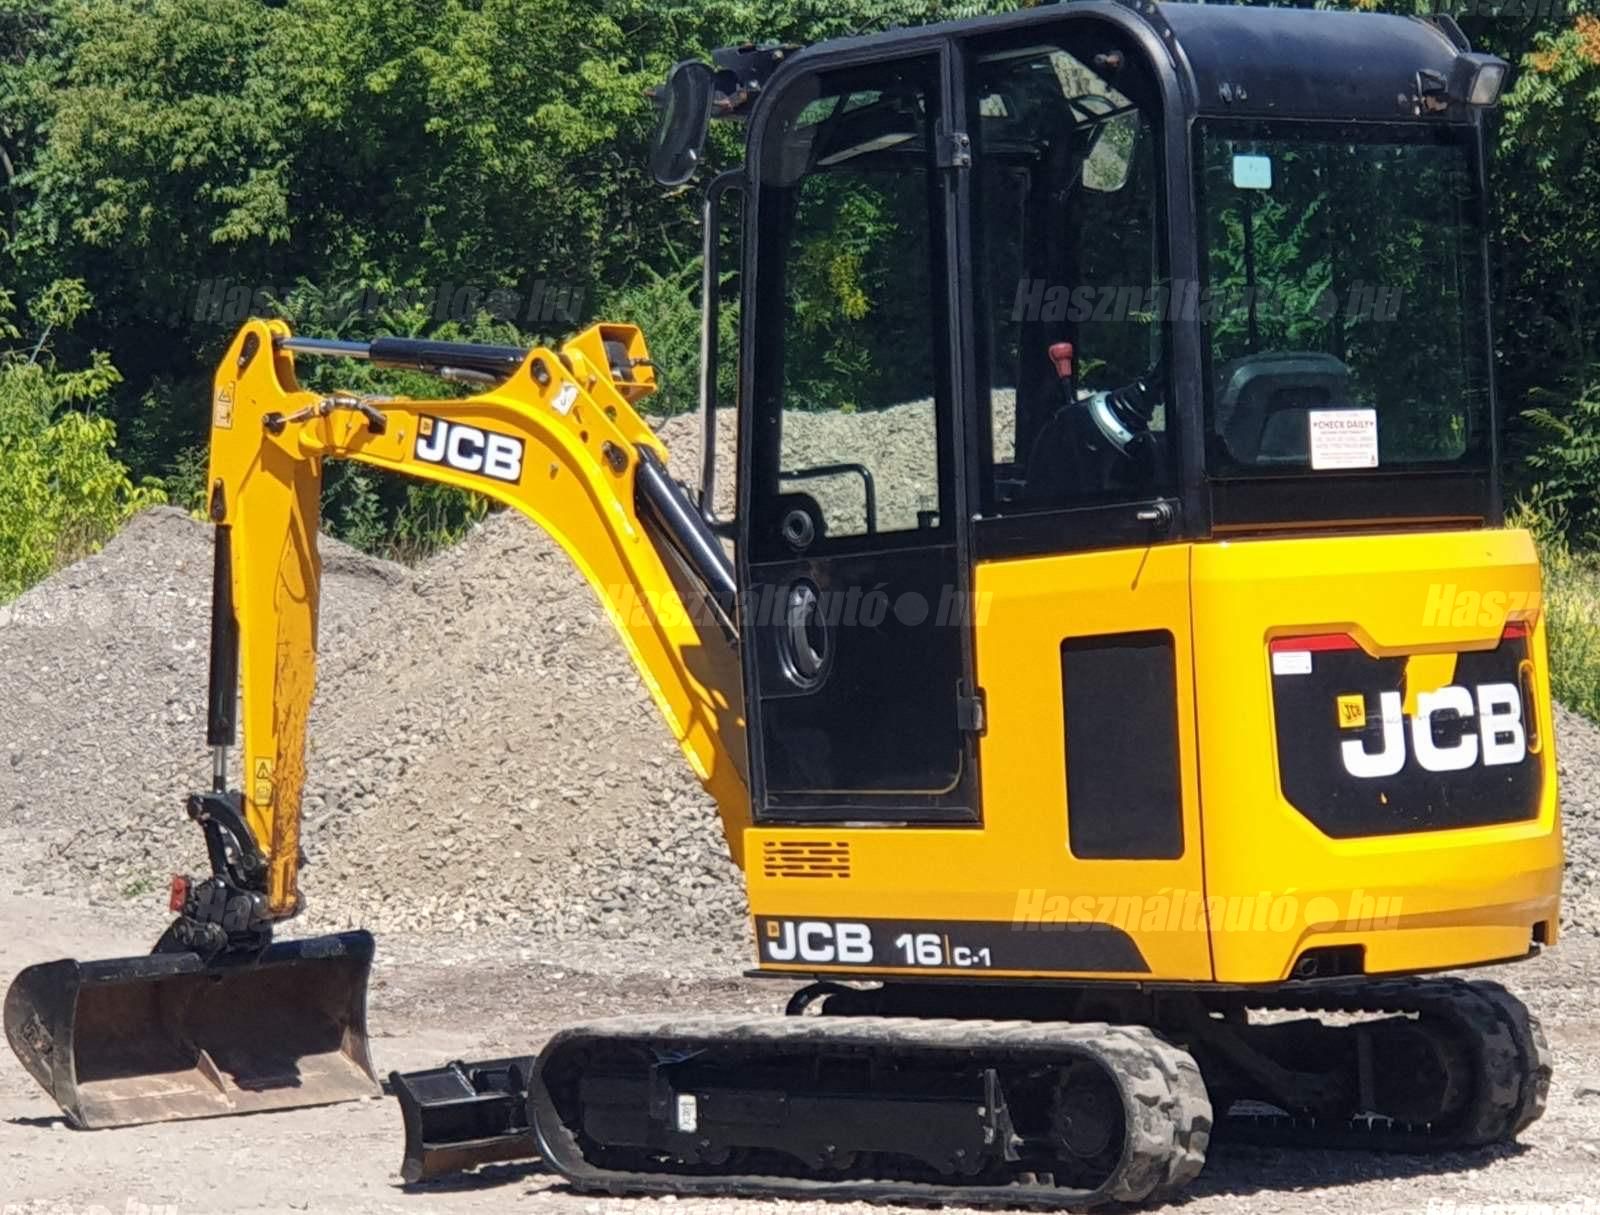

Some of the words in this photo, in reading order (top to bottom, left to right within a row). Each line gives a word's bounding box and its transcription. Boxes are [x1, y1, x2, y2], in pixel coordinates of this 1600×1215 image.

[416, 420, 522, 480] JCB
[1341, 683, 1526, 778] JCB
[768, 920, 874, 963] JCB
[895, 933, 943, 966] 16
